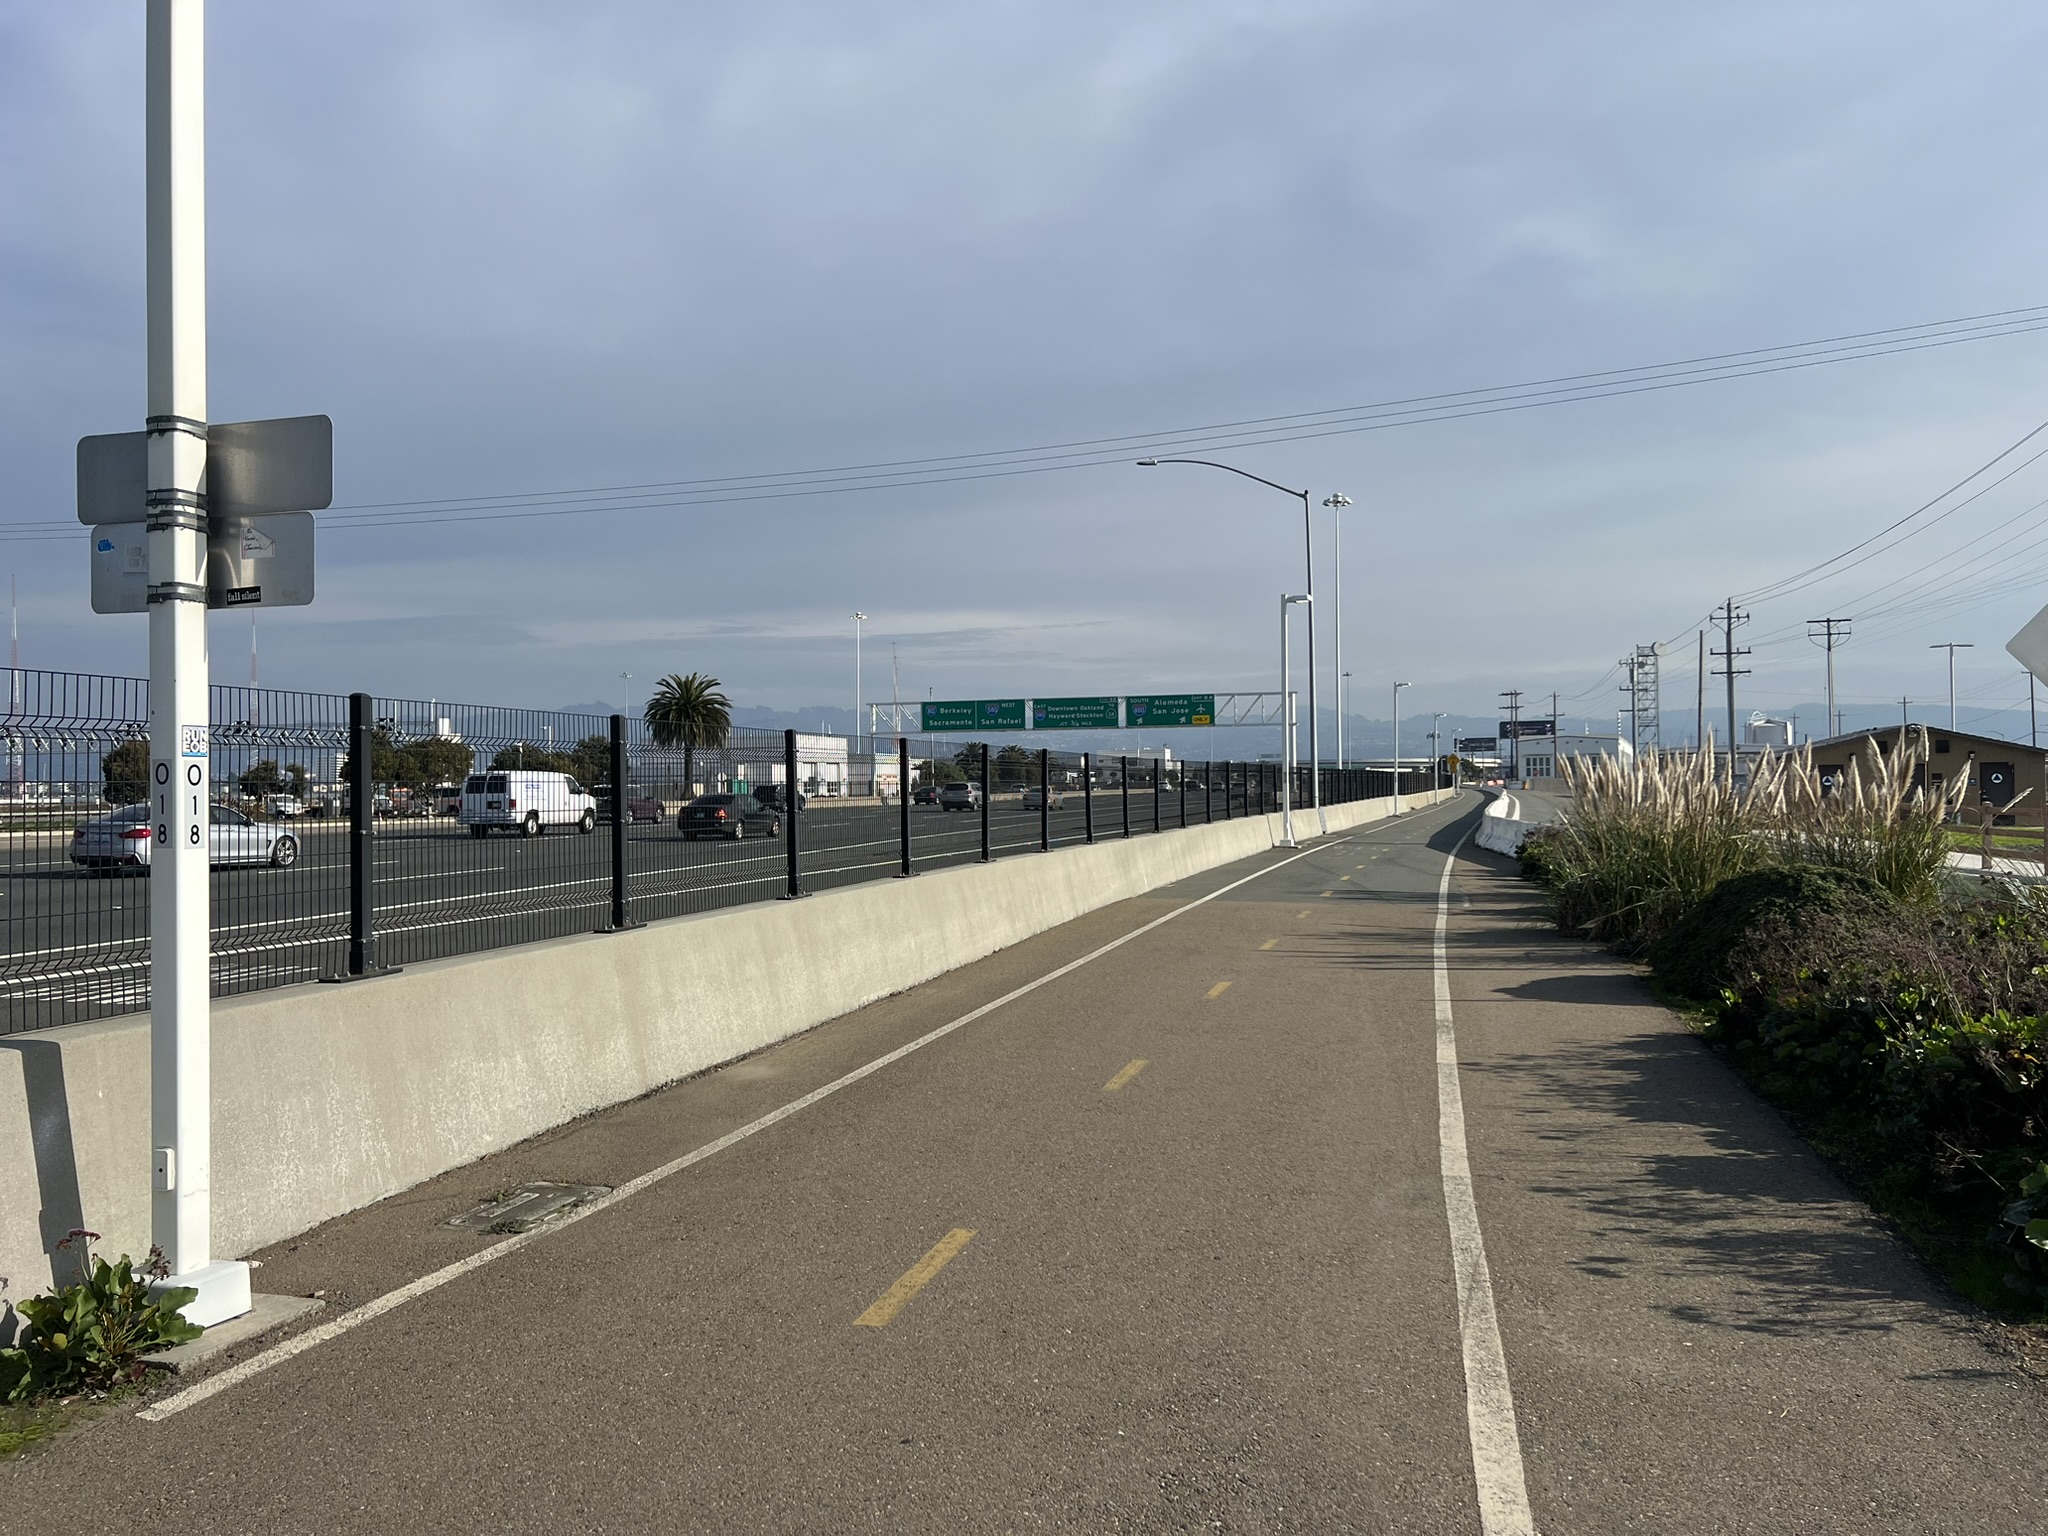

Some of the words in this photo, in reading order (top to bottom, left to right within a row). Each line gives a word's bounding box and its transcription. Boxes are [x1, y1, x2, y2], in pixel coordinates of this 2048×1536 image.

[227, 591, 241, 602] fall
[241, 590, 261, 601] silent
[940, 707, 972, 716] Berkeley
[929, 719, 973, 727] Sacramento
[997, 717, 1021, 725] Rafael
[183, 728, 208, 743] RUN
[155, 762, 169, 844] 018
[187, 764, 202, 845] 018
